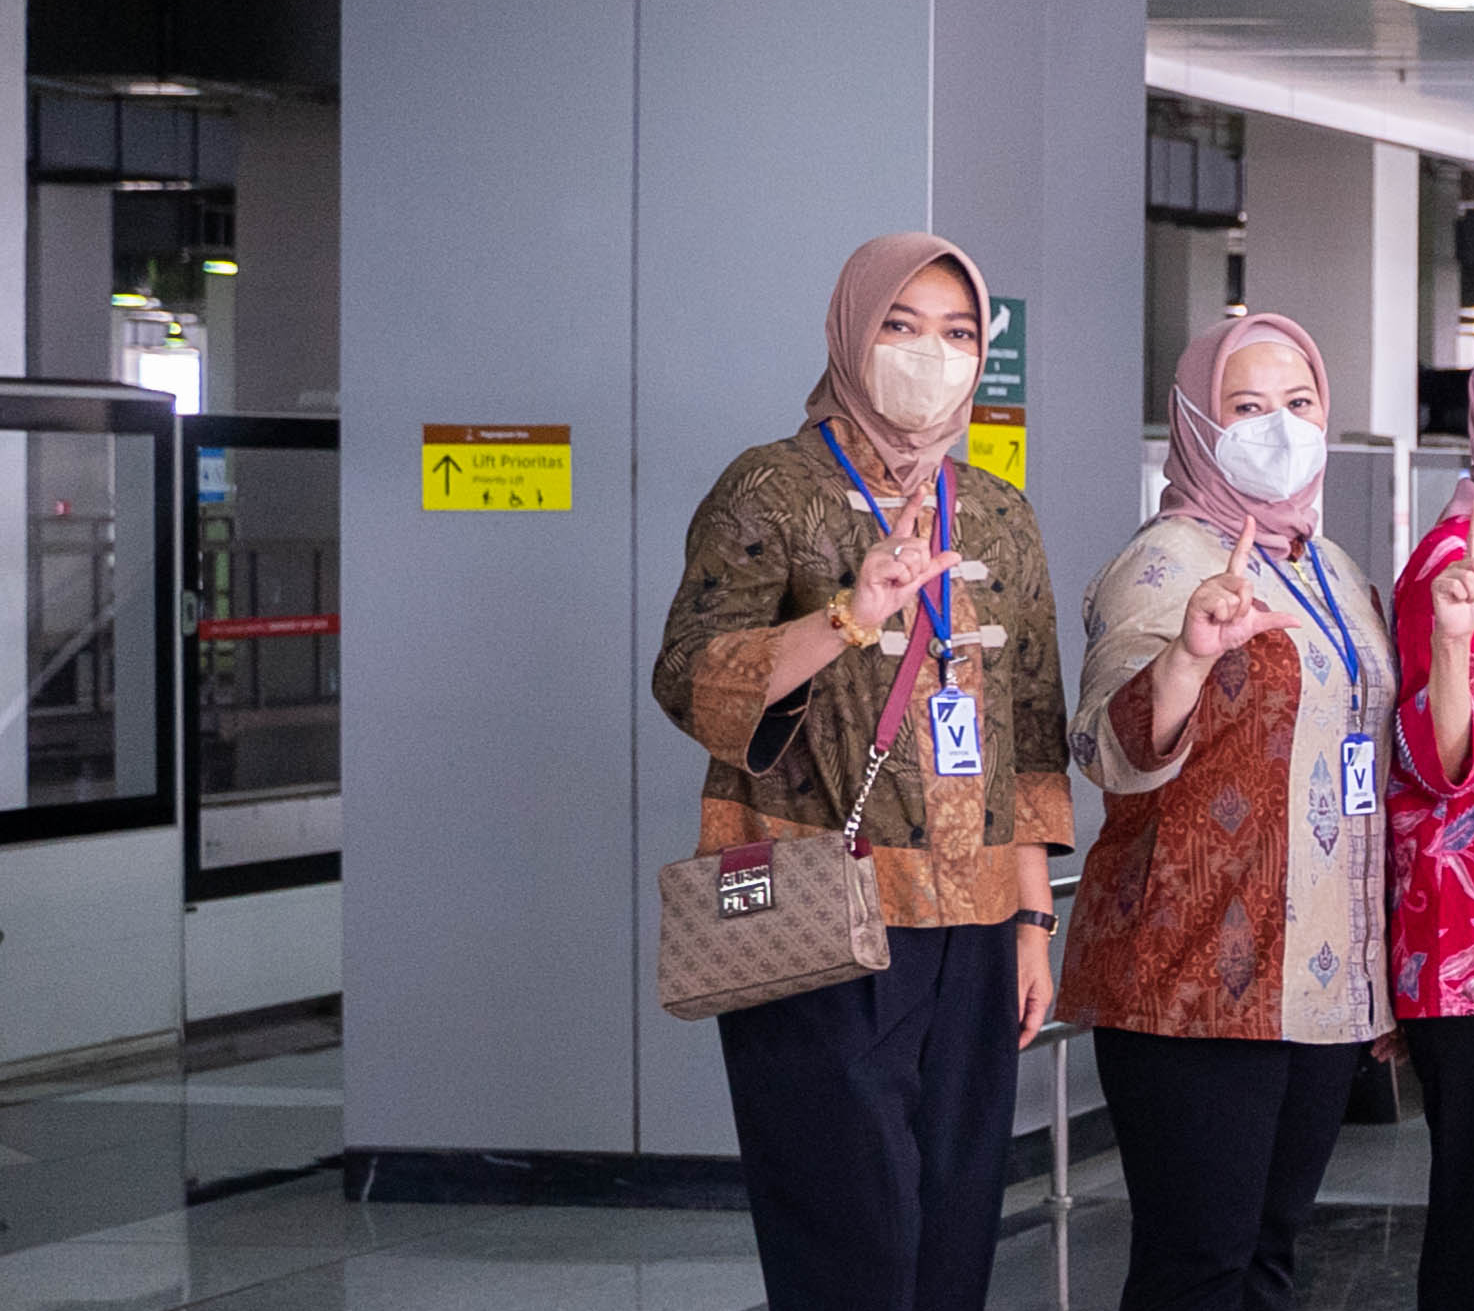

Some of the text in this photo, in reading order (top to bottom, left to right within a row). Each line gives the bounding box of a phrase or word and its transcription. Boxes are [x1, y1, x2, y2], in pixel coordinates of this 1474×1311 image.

[472, 454, 564, 468] Lift Prioritas
[948, 725, 965, 748] V
[1353, 768, 1366, 789] V
